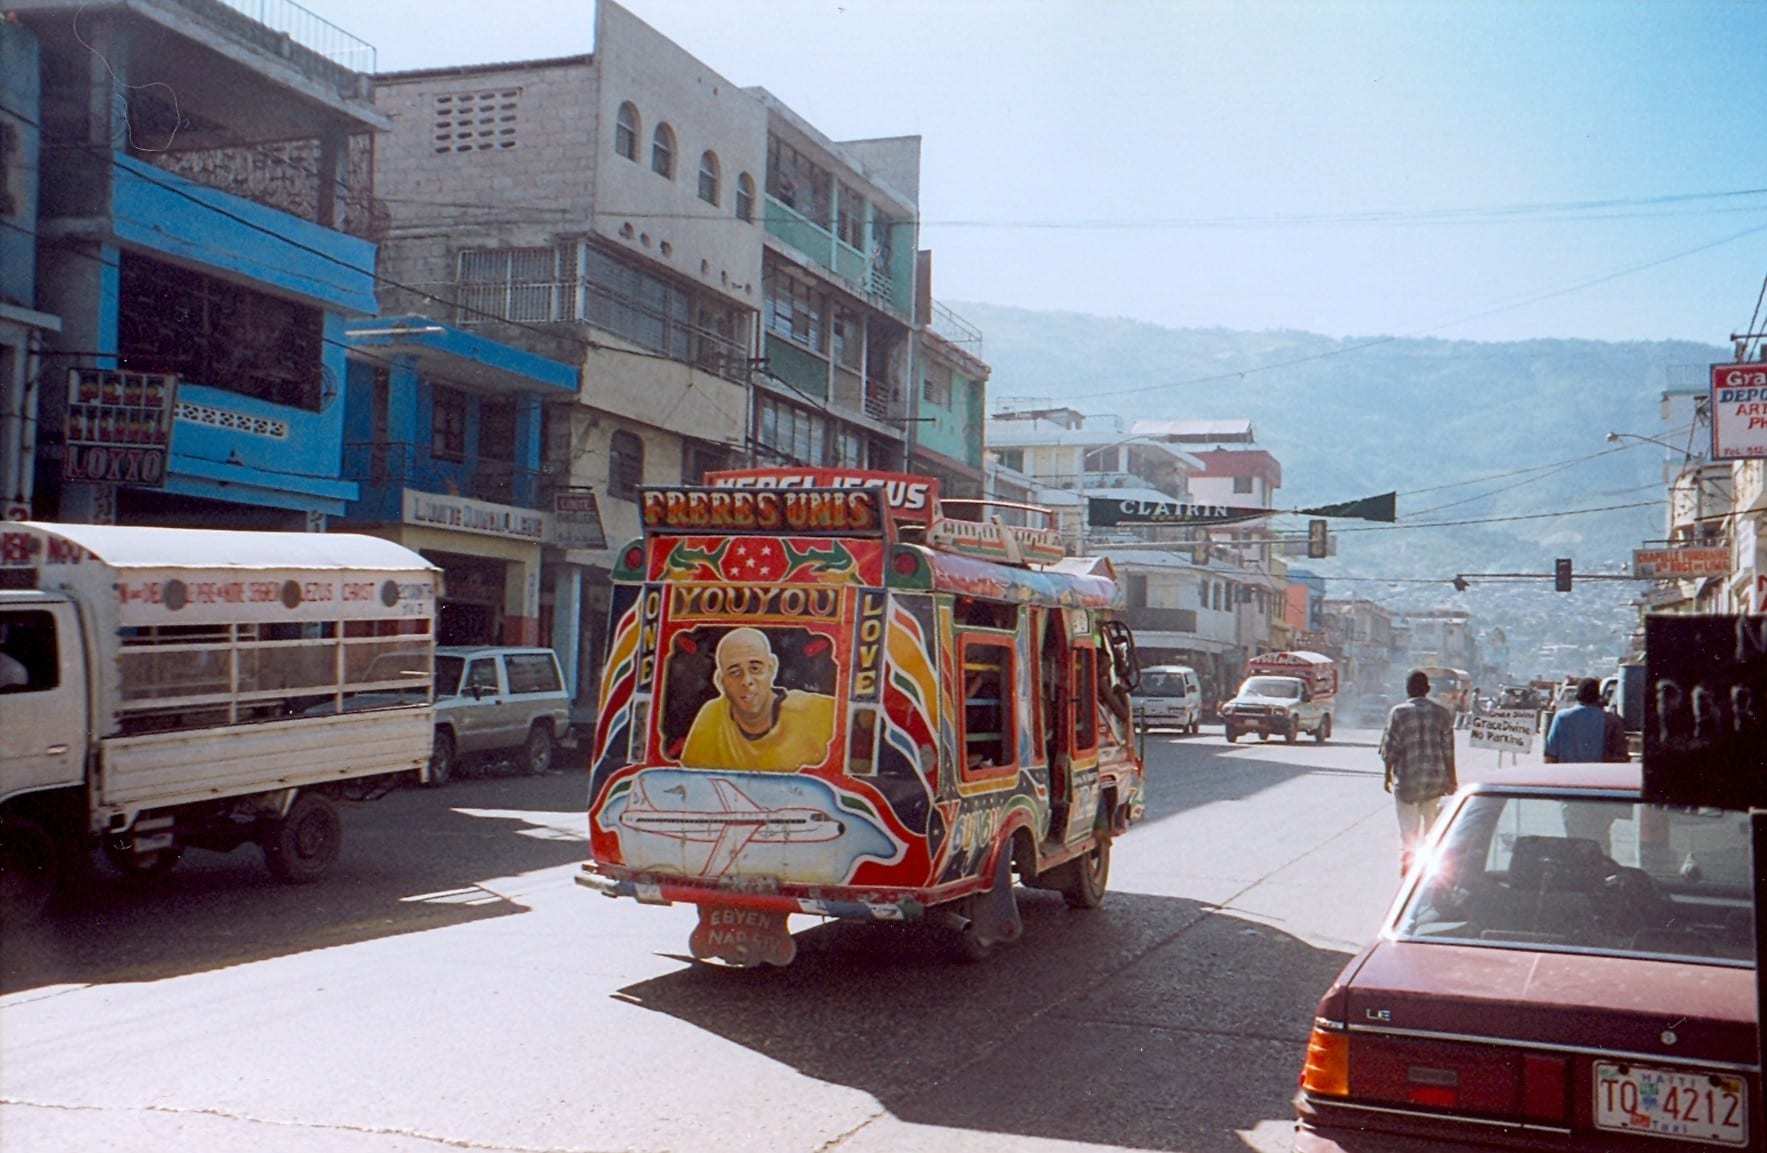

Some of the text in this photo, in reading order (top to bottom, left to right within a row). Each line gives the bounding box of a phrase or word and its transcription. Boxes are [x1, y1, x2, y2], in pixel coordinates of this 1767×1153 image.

[783, 491, 872, 529] UNIS
[1119, 499, 1229, 518] CLAIRIN
[678, 586, 836, 617] YOUYOU
[639, 591, 660, 685] ONE
[855, 594, 884, 694] LOVE
[1471, 730, 1524, 746] No Parking
[1366, 1007, 1391, 1021] LE
[1641, 1073, 1696, 1089] HAITI
[1662, 1086, 1741, 1128] 4212
